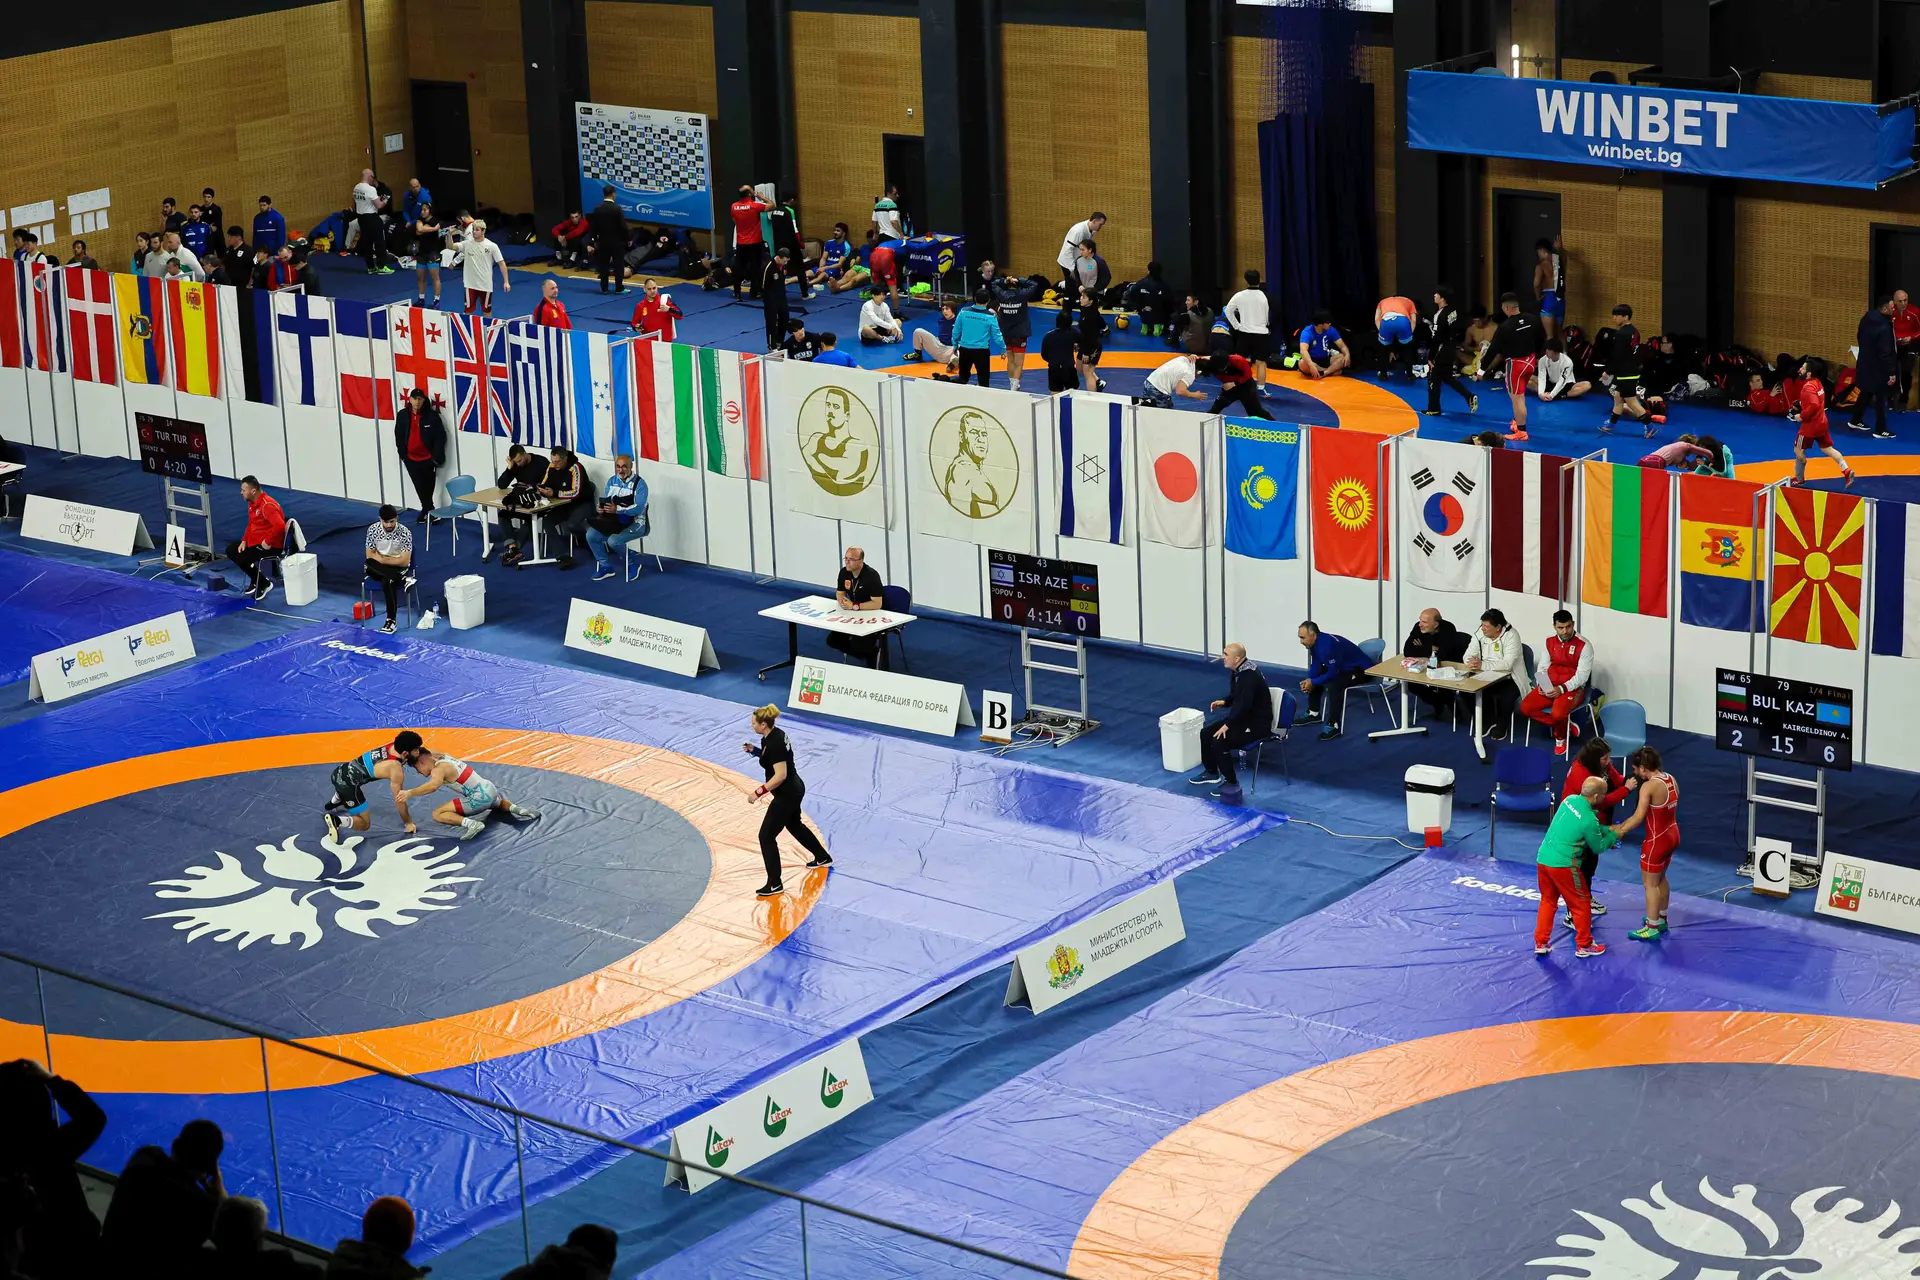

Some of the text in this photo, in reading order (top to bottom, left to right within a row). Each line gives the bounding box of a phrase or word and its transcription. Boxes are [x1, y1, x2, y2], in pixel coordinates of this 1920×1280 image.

[1535, 87, 1739, 149] WINBET
[1587, 141, 1682, 168] winbet.bg
[154, 430, 188, 445] TUR TUR
[149, 457, 156, 470] 0
[164, 459, 187, 475] 4:20
[195, 465, 203, 479] 2
[168, 534, 182, 559] A
[994, 552, 1017, 563] FS 61
[1036, 558, 1048, 568] 43
[1018, 571, 1069, 590] ISR AZE
[1003, 603, 1013, 619] 0
[1079, 601, 1089, 611] 02
[1027, 607, 1062, 626] 4:14
[1077, 615, 1086, 631] 0
[622, 625, 673, 644] МИНИСТЕРСТВО
[673, 637, 683, 646] НА
[619, 635, 651, 650] МЛАДЕЖТА
[658, 645, 683, 657] СПОРТА
[1723, 672, 1751, 684] WW 65
[1777, 680, 1790, 691] 79
[827, 684, 948, 714] БЪЛГАРСКА ФЕДЕРАЦИЯ ПО БОРБА
[1752, 694, 1815, 716] BUL KAZ
[987, 700, 1007, 730] B
[1717, 710, 1763, 726] TANEVA M.
[1731, 729, 1743, 748] 2
[1771, 735, 1794, 755] 15
[1823, 745, 1836, 763] 6
[1759, 850, 1787, 883] C
[1450, 876, 1566, 906] foelde
[1867, 887, 1920, 907] БЪЛГАРСКА
[1089, 907, 1158, 948] МИНИСТЕРСТВО НА
[1090, 919, 1164, 963] МЛАДЕЖТА И СПОРТА
[827, 1078, 849, 1094] Litax
[770, 1107, 792, 1123] Litax
[712, 1136, 735, 1154] Litax
